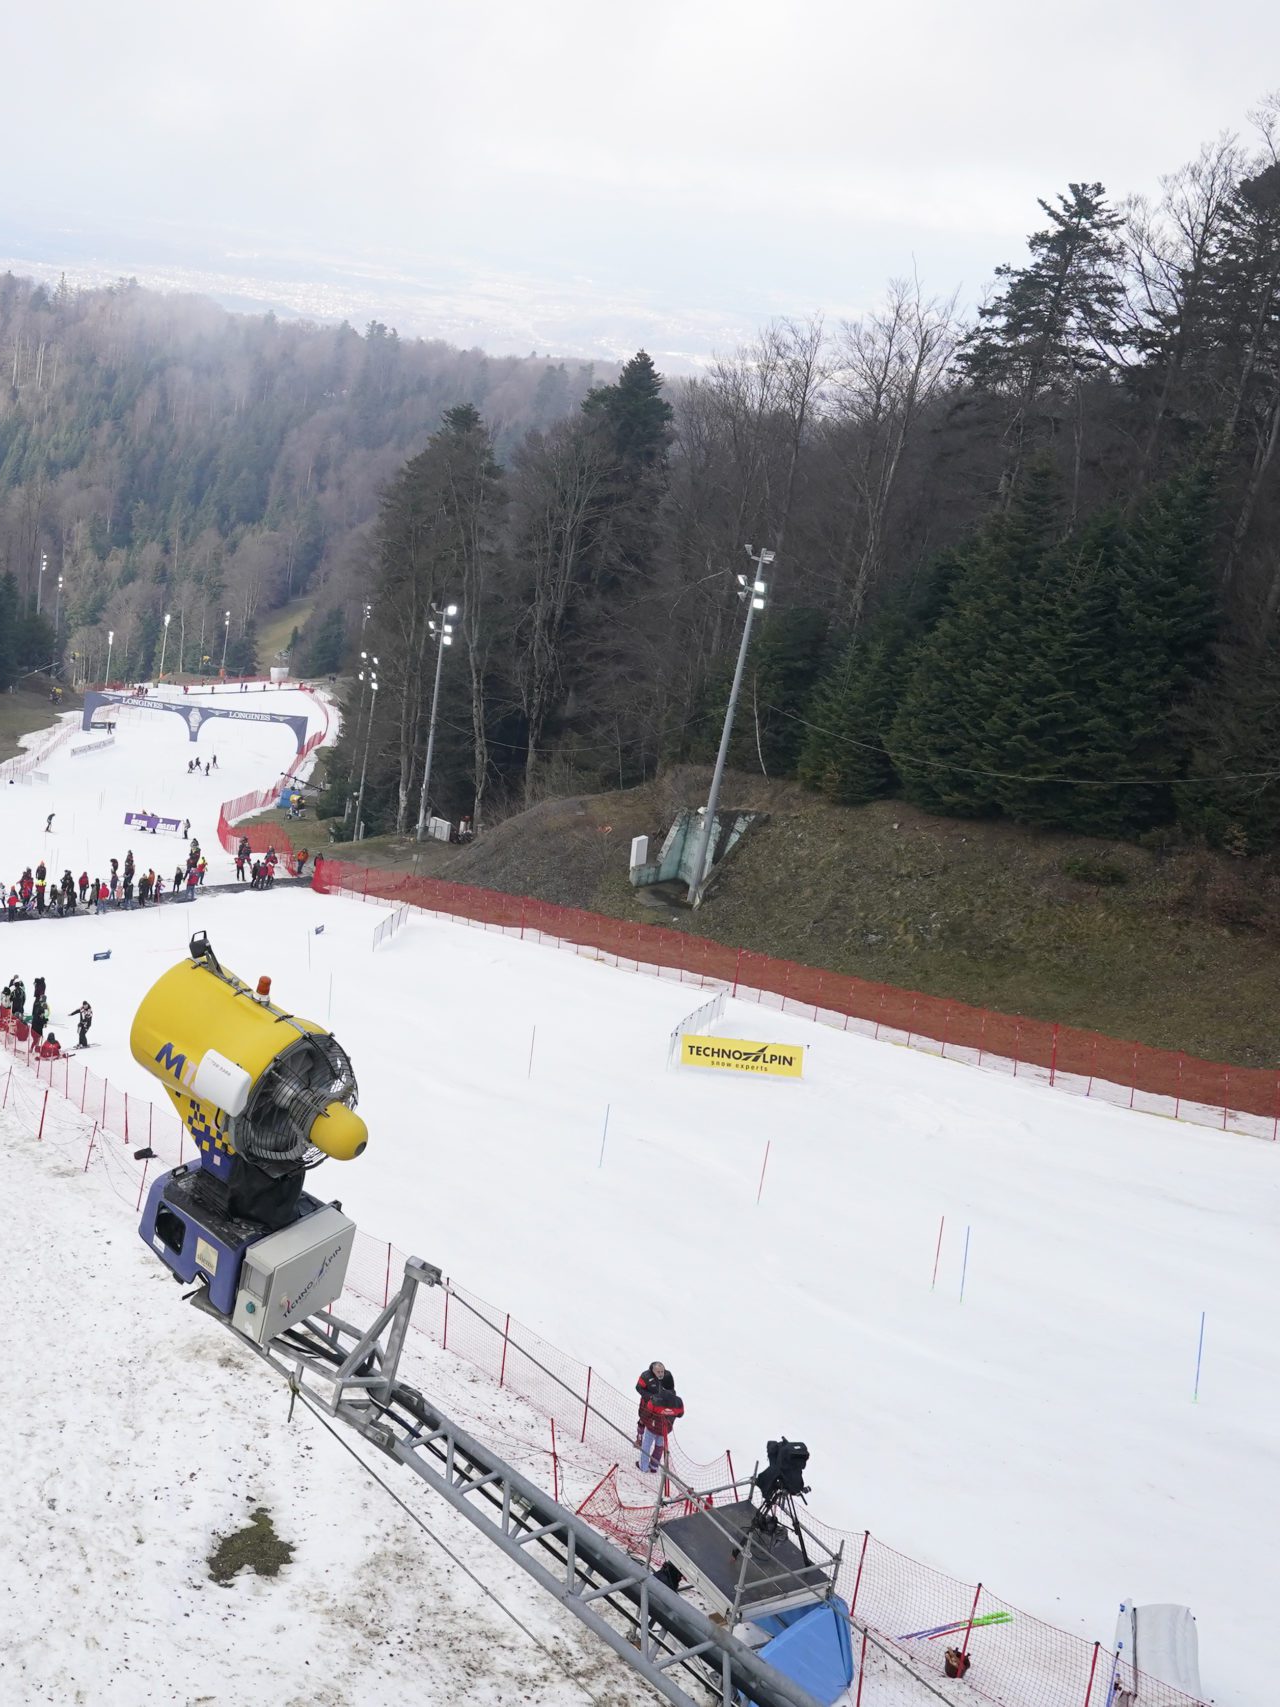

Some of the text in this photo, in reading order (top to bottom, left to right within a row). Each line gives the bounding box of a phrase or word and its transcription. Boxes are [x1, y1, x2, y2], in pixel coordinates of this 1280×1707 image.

[122, 697, 164, 709] LONGINES
[228, 711, 271, 721] LONGINES
[688, 1045, 793, 1066] TECHNOALPIN
[735, 1063, 768, 1072] experts
